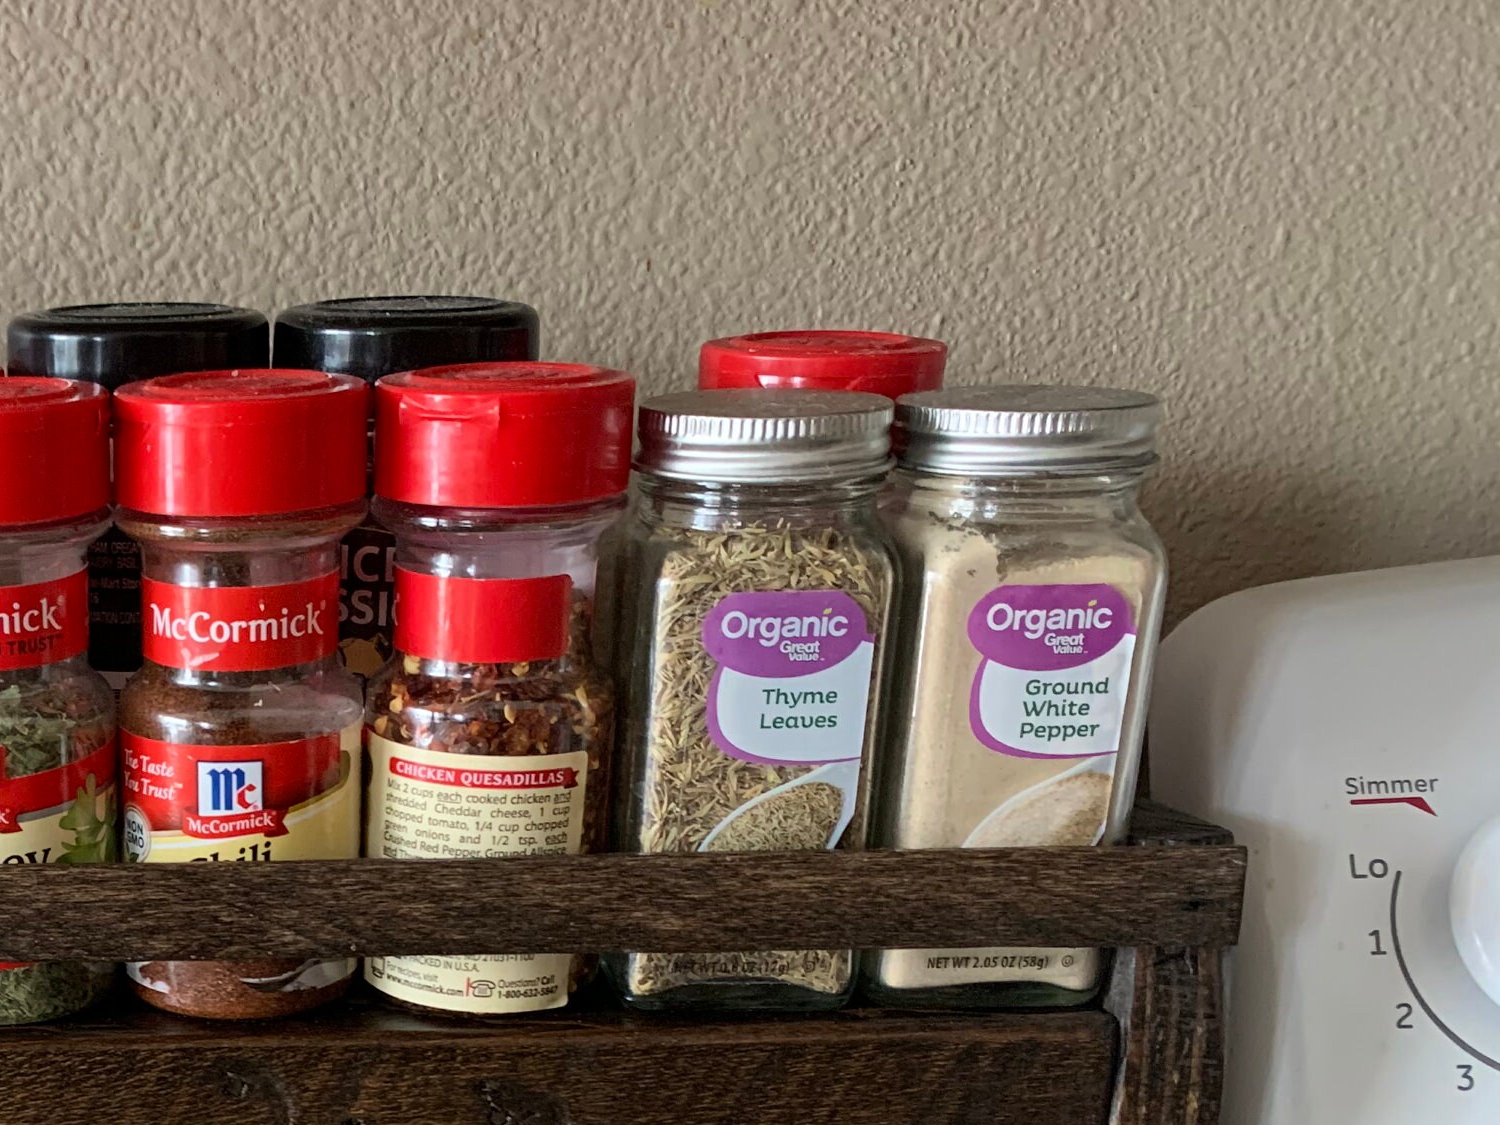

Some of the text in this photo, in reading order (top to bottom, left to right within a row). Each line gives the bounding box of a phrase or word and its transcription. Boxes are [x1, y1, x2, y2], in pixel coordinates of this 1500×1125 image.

[150, 602, 325, 644] McCormick
[721, 607, 849, 647] Organic
[986, 600, 1113, 640] Organic
[8, 637, 55, 655] TRUST
[780, 640, 821, 654] Great
[1044, 633, 1085, 647] Great
[789, 652, 820, 662] Value
[1052, 645, 1084, 655] Value
[1025, 677, 1110, 696] Ground
[761, 688, 838, 709] Thyme
[1022, 699, 1090, 717] White
[760, 713, 838, 730] Leaves
[1019, 722, 1100, 742] Pepper
[140, 754, 176, 778] Taste
[395, 760, 565, 787] CHICKEN QUESADILLAS
[403, 782, 409, 794] 2
[411, 786, 434, 799] cups
[436, 790, 462, 803] each
[465, 793, 508, 805] cooked
[510, 792, 551, 805] chicken
[553, 789, 572, 804] and
[1344, 776, 1440, 796] Simmer
[434, 803, 482, 817] Cheddar
[490, 807, 532, 820] cheese,
[539, 807, 545, 817] 1
[552, 805, 571, 817] cup
[186, 812, 275, 835] McCormick
[475, 821, 493, 832] 1/4
[498, 822, 520, 834] cup
[524, 817, 570, 833] chopped
[414, 828, 451, 842] onions
[459, 833, 482, 845] and
[492, 835, 509, 846] 1/2
[544, 831, 568, 846] each
[419, 840, 440, 854] Red
[1349, 853, 1389, 879] Lo
[1368, 929, 1388, 956] 1
[443, 960, 453, 970] IN
[926, 954, 1050, 971] NET WT 2.05 OZ (58g)
[1395, 1002, 1414, 1029] 2
[1456, 1064, 1475, 1092] 3
